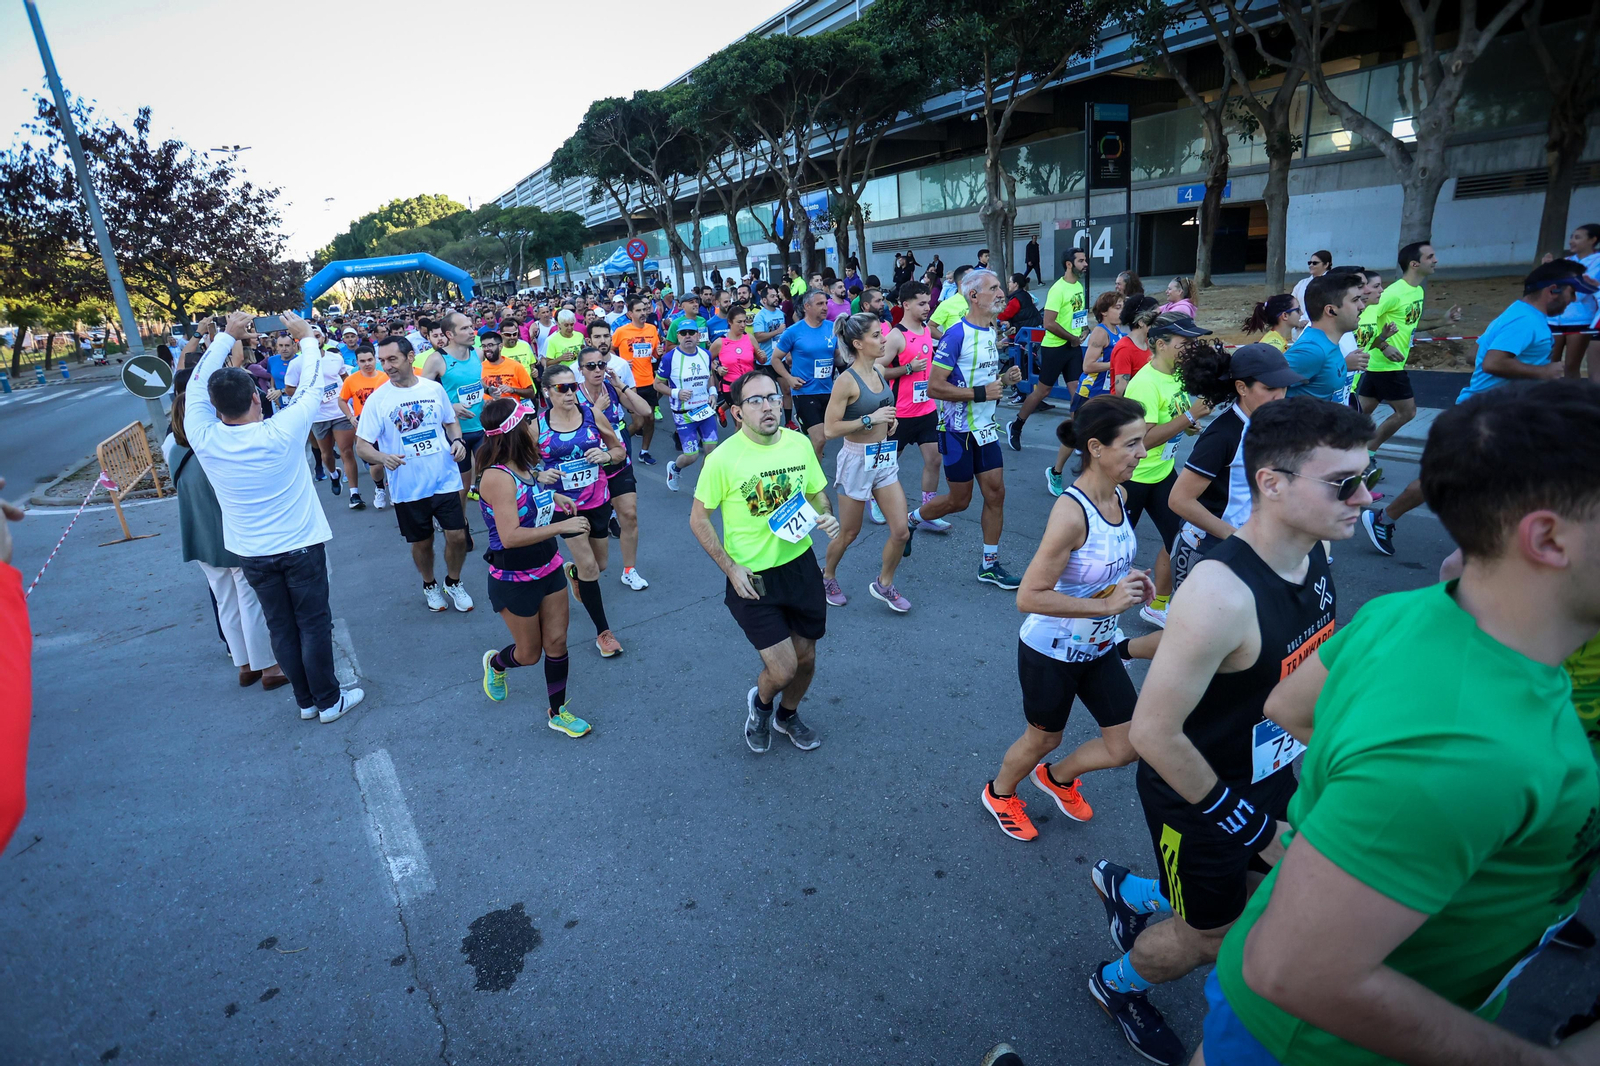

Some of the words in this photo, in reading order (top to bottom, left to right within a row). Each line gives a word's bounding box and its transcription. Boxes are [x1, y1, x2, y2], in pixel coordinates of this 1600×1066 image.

[1184, 188, 1192, 200] 4
[1075, 218, 1096, 227] Tribna
[466, 390, 480, 401] 467
[980, 429, 992, 439] 874
[412, 440, 432, 452] 193
[572, 470, 592, 482] 473
[760, 468, 786, 478] CARRERA
[783, 512, 807, 535] 721
[1286, 635, 1303, 654] RULE
[1304, 624, 1315, 640] THE
[1316, 612, 1331, 630] CITY
